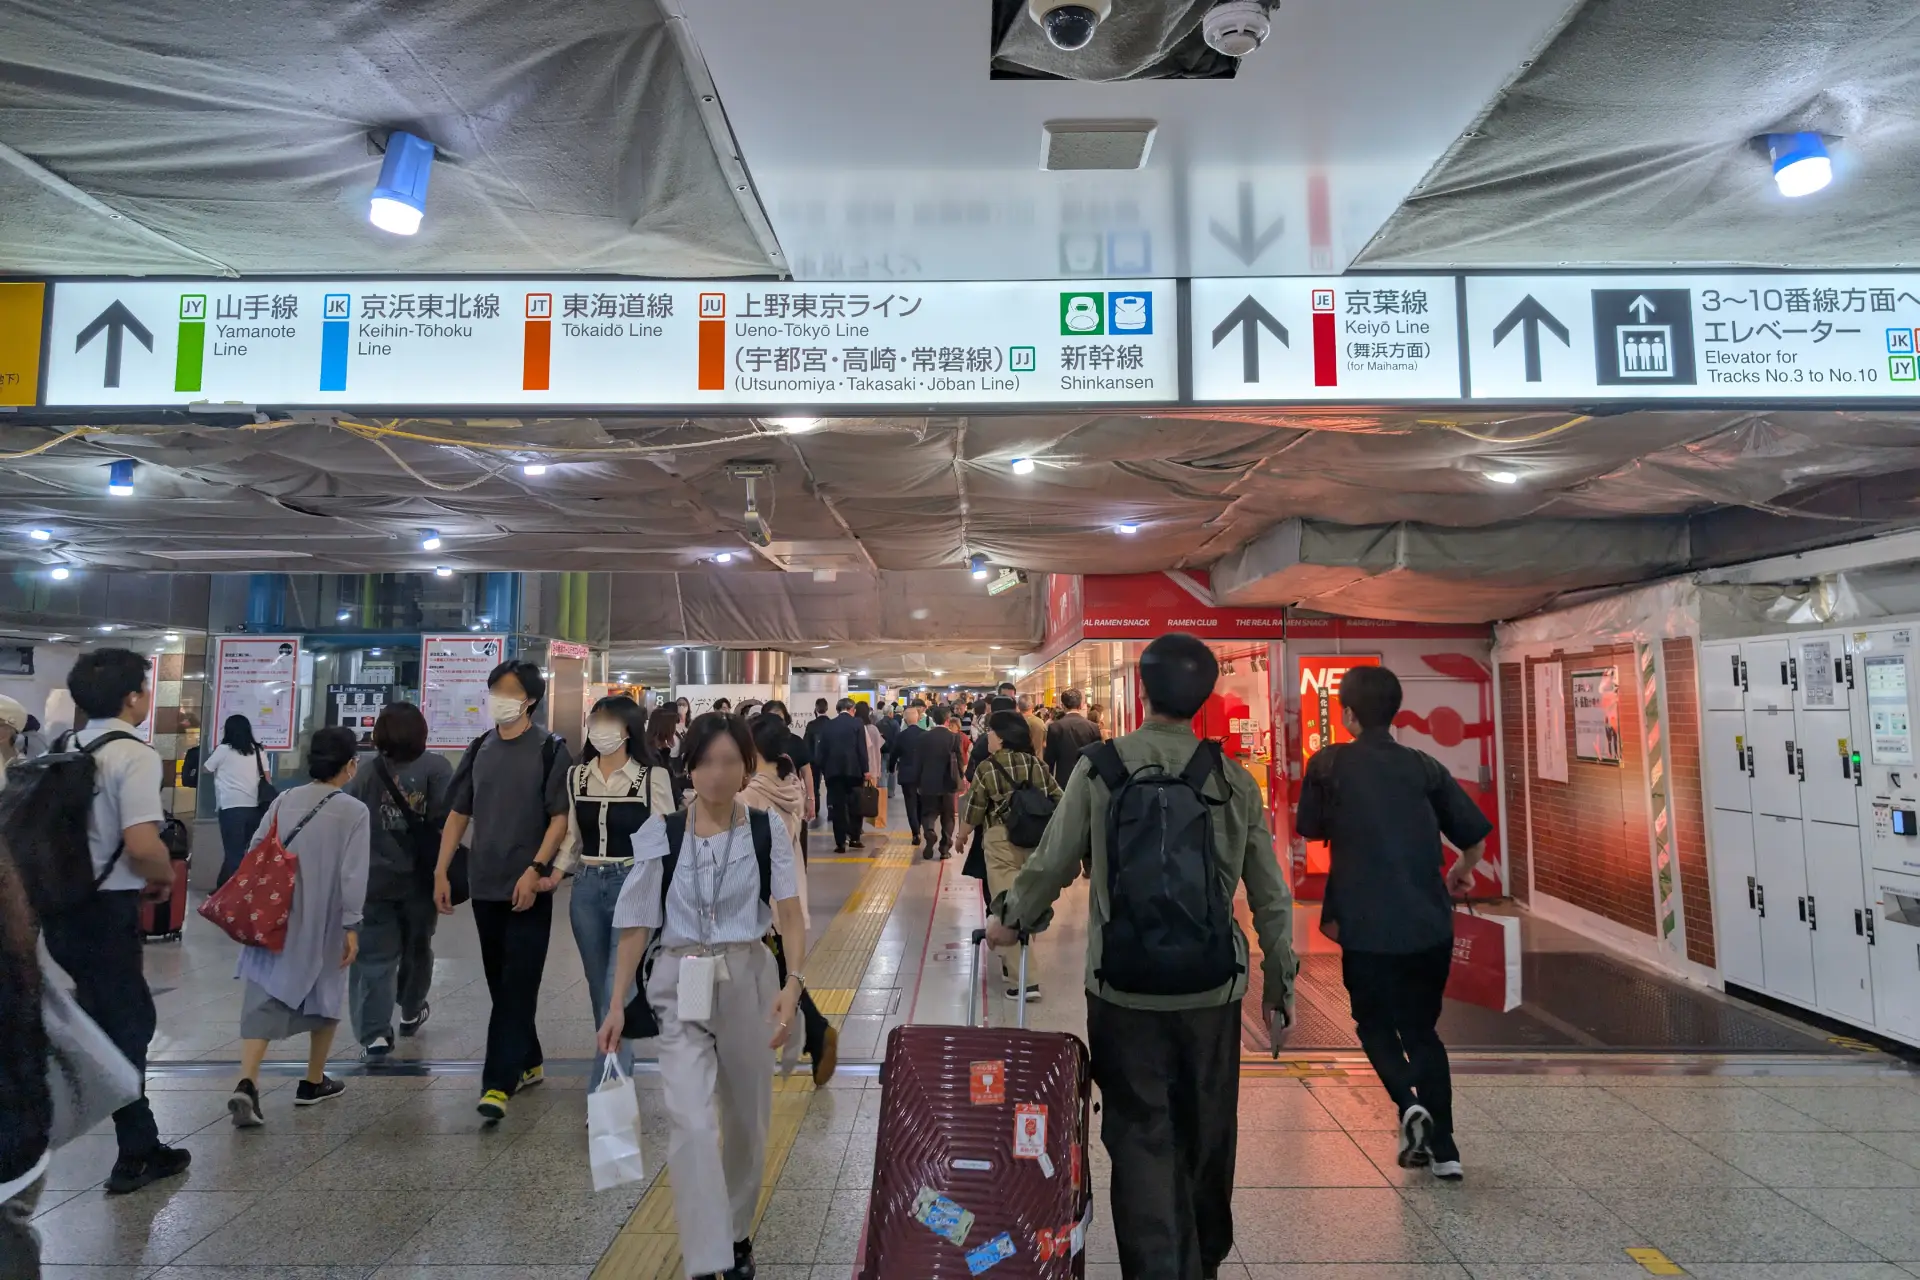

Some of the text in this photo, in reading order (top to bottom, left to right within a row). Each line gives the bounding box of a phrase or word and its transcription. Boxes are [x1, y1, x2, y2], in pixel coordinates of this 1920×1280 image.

[185, 302, 203, 313] JY
[216, 293, 298, 319] 山手線
[329, 301, 346, 313] JK
[360, 293, 500, 319] 京浜東北線
[531, 300, 547, 312] JT
[562, 293, 674, 319] 東海道線
[703, 300, 720, 312] JU
[735, 293, 922, 319] 上野東京ライン
[1316, 295, 1329, 306] JE
[1344, 290, 1429, 315] 京葉線
[216, 324, 296, 339] Yamanote
[359, 322, 472, 338] Keihin-Tōhoku
[562, 321, 663, 337] Tōkaidō Line
[735, 322, 869, 341] Ueno-Tōkyō Line
[1345, 320, 1430, 337] Keiyō Line
[1704, 319, 1861, 344] エレベーター
[1891, 334, 1909, 347] JK
[213, 342, 247, 356] Line
[358, 341, 391, 356] Line
[1346, 341, 1431, 359] (舞浜方面)
[1015, 352, 1030, 366] JJ
[1060, 344, 1144, 371] 新幹線
[1705, 350, 1798, 364] Elevator for
[1347, 360, 1418, 372] (for Maihama)
[1893, 362, 1911, 375] JY
[981, 375, 1020, 391] Line)
[1060, 375, 1154, 390] Shinkansen
[1707, 368, 1878, 383] Tracks No.3 to No.10
[1123, 619, 1150, 627] SNACK
[1167, 619, 1218, 627] RAMEN CLUB
[1300, 668, 1350, 695] NE
[656, 695, 664, 707] 8
